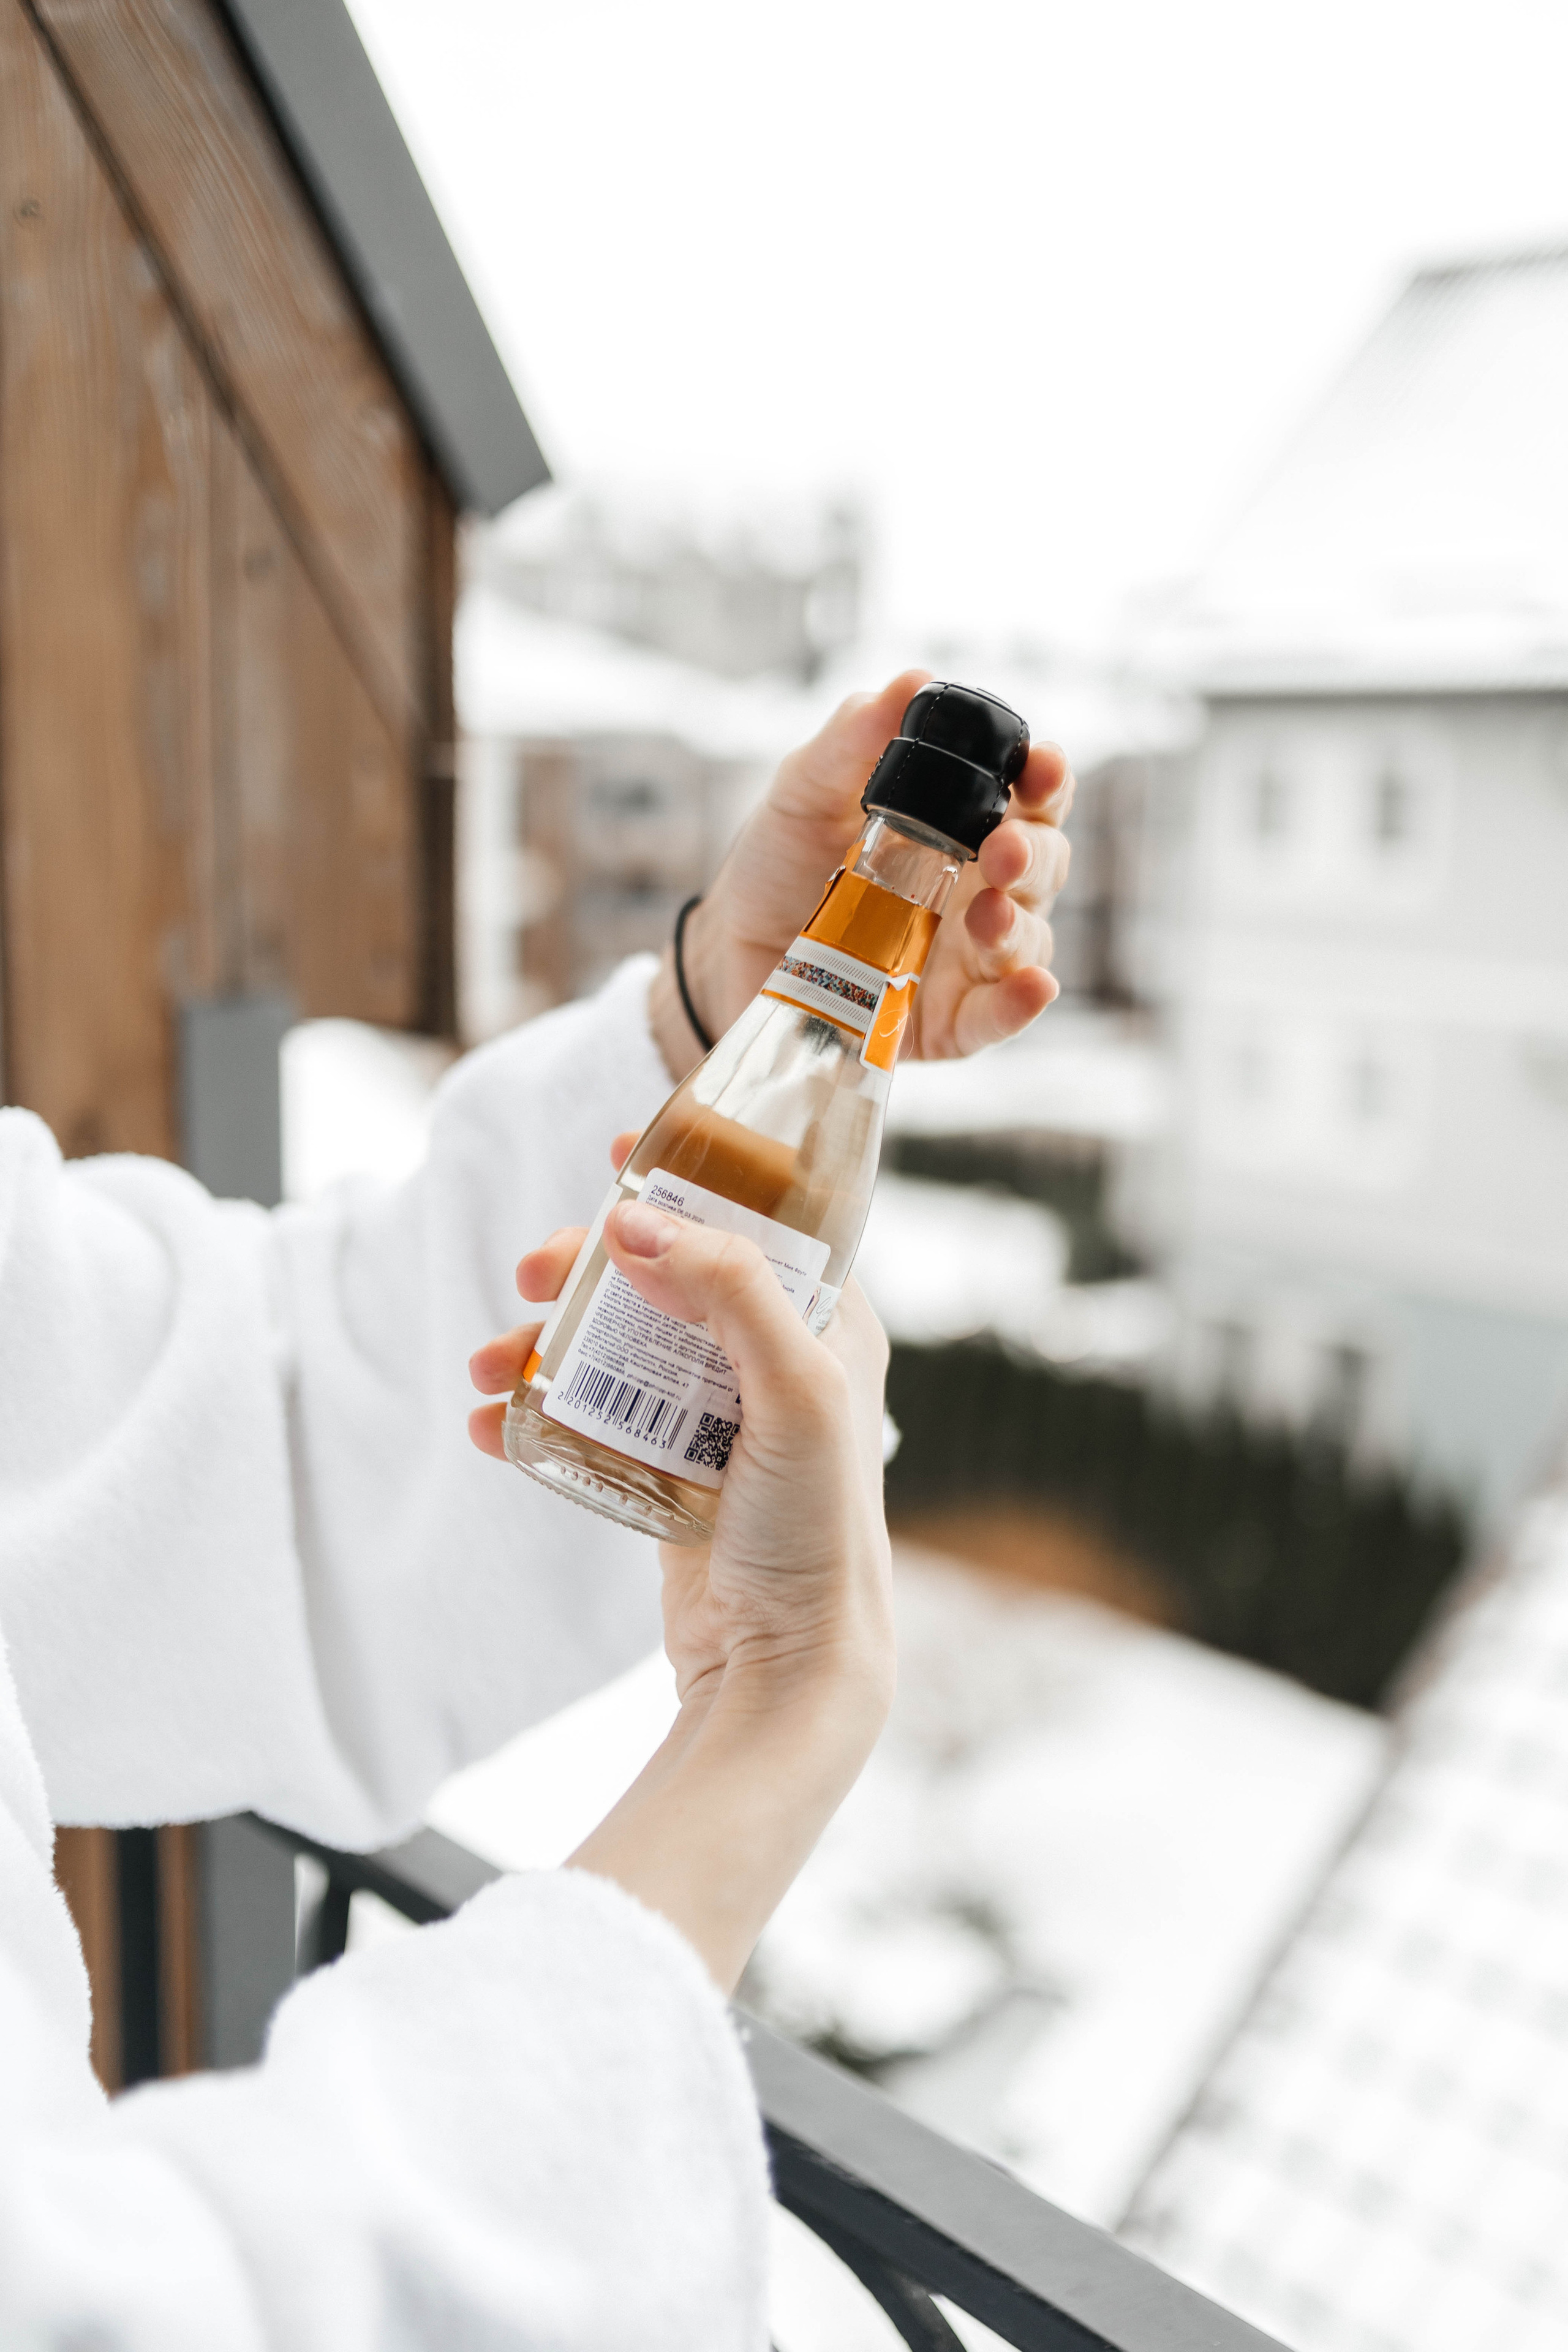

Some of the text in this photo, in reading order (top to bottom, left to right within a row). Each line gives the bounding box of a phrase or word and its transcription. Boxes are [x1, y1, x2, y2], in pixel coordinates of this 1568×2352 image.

[651, 1185, 685, 1207] 256846
[592, 1317, 647, 1348] ЗДОРОВЬЮ ЧЕЛОВЕКА
[595, 1311, 627, 1330] ЧРЕЗМЕРНОЕ
[627, 1327, 672, 1352] УПОТРЕБЛЕНИЕ
[673, 1349, 704, 1366] АЛКОГОЛЯ
[704, 1362, 727, 1375] ВРЕДИТ
[616, 1345, 629, 1354] ООО
[567, 1396, 611, 1425] 201252
[617, 1421, 667, 1449] 568463
